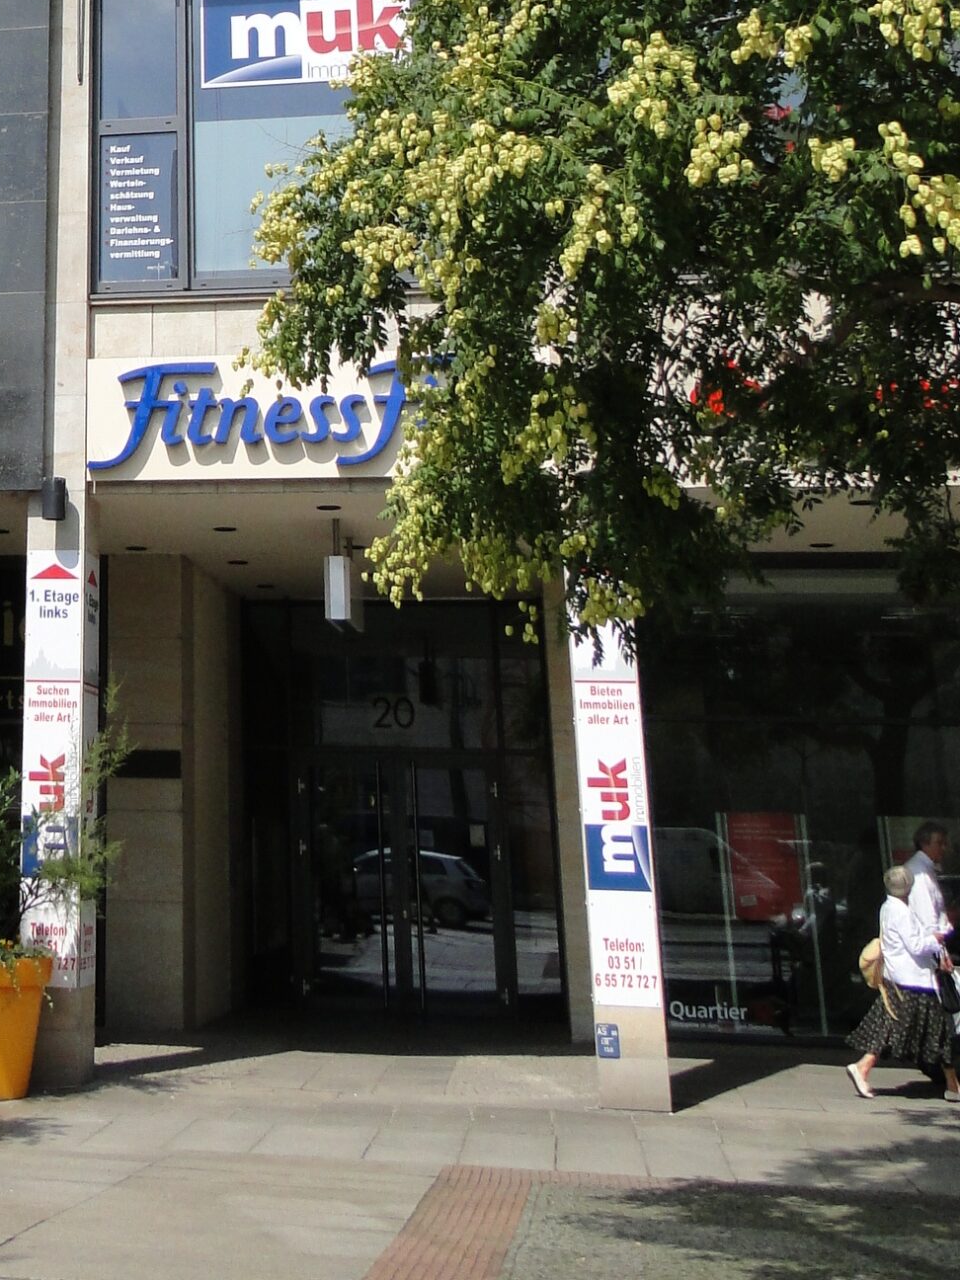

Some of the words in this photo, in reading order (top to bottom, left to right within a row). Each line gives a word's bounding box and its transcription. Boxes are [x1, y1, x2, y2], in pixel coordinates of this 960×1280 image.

[307, 63, 348, 79] Imm
[110, 145, 131, 153] Kauf
[110, 155, 144, 165] Verkauf
[110, 167, 160, 176] Vermietung
[110, 179, 147, 188] Wertein-
[110, 191, 154, 200] schätzung
[110, 203, 135, 211] Haus-
[110, 214, 158, 223] verwaltung
[110, 236, 174, 247] Finanzierungs-
[110, 250, 160, 259] vermittlung
[29, 590, 39, 603] 1.
[44, 589, 79, 606] Etage
[39, 605, 69, 619] links
[36, 685, 70, 696] Suchen
[589, 685, 623, 697] Bieten
[28, 698, 78, 709] Immobilien
[579, 699, 635, 710] Immobilien
[34, 712, 54, 723] aller
[57, 712, 71, 723] Art
[373, 697, 415, 729] 20
[587, 715, 610, 725] aller
[613, 714, 629, 726] Art
[587, 757, 636, 873] muk
[603, 937, 645, 953] Telefon:
[607, 955, 620, 970] 03
[624, 956, 636, 970] 51
[669, 1000, 748, 1021] Quartier
